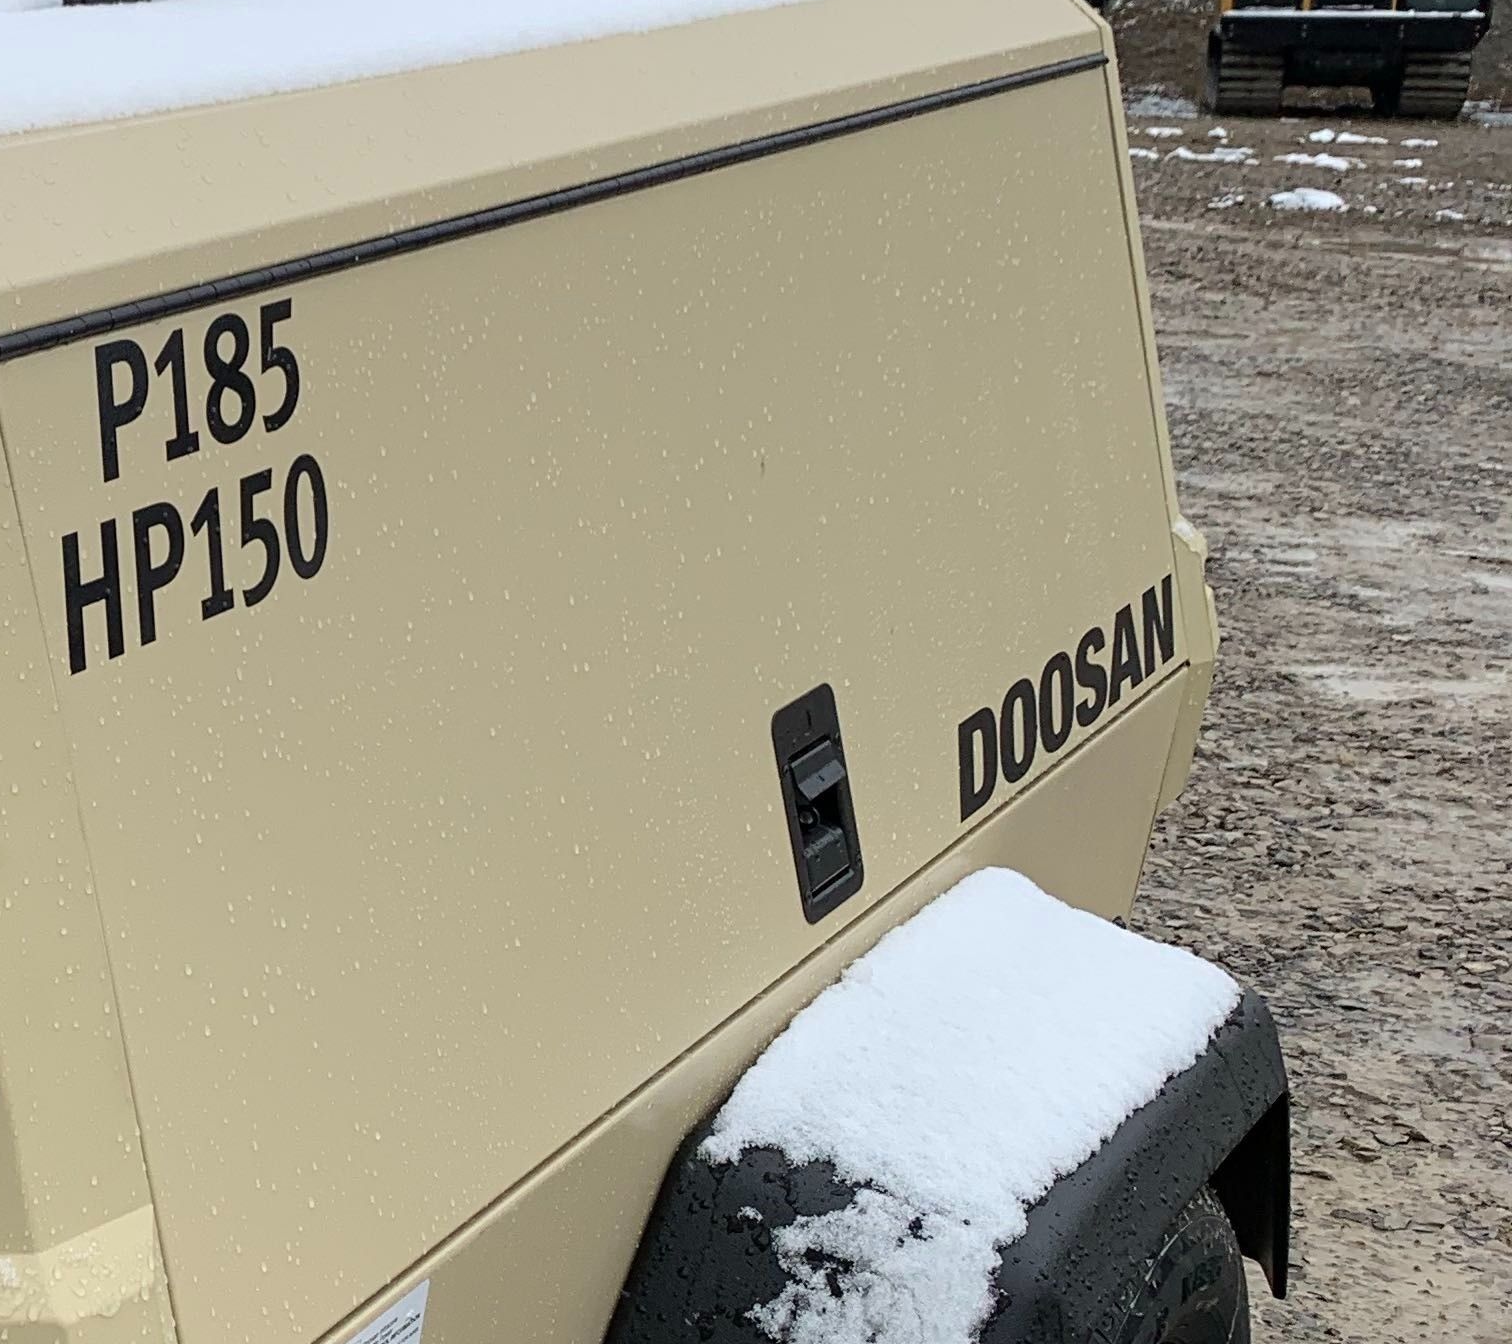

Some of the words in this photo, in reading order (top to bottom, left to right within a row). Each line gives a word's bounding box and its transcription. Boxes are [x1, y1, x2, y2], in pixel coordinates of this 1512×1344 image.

[95, 298, 300, 483] P185
[62, 454, 328, 675] HP150
[958, 573, 1175, 823] DOOSAN
